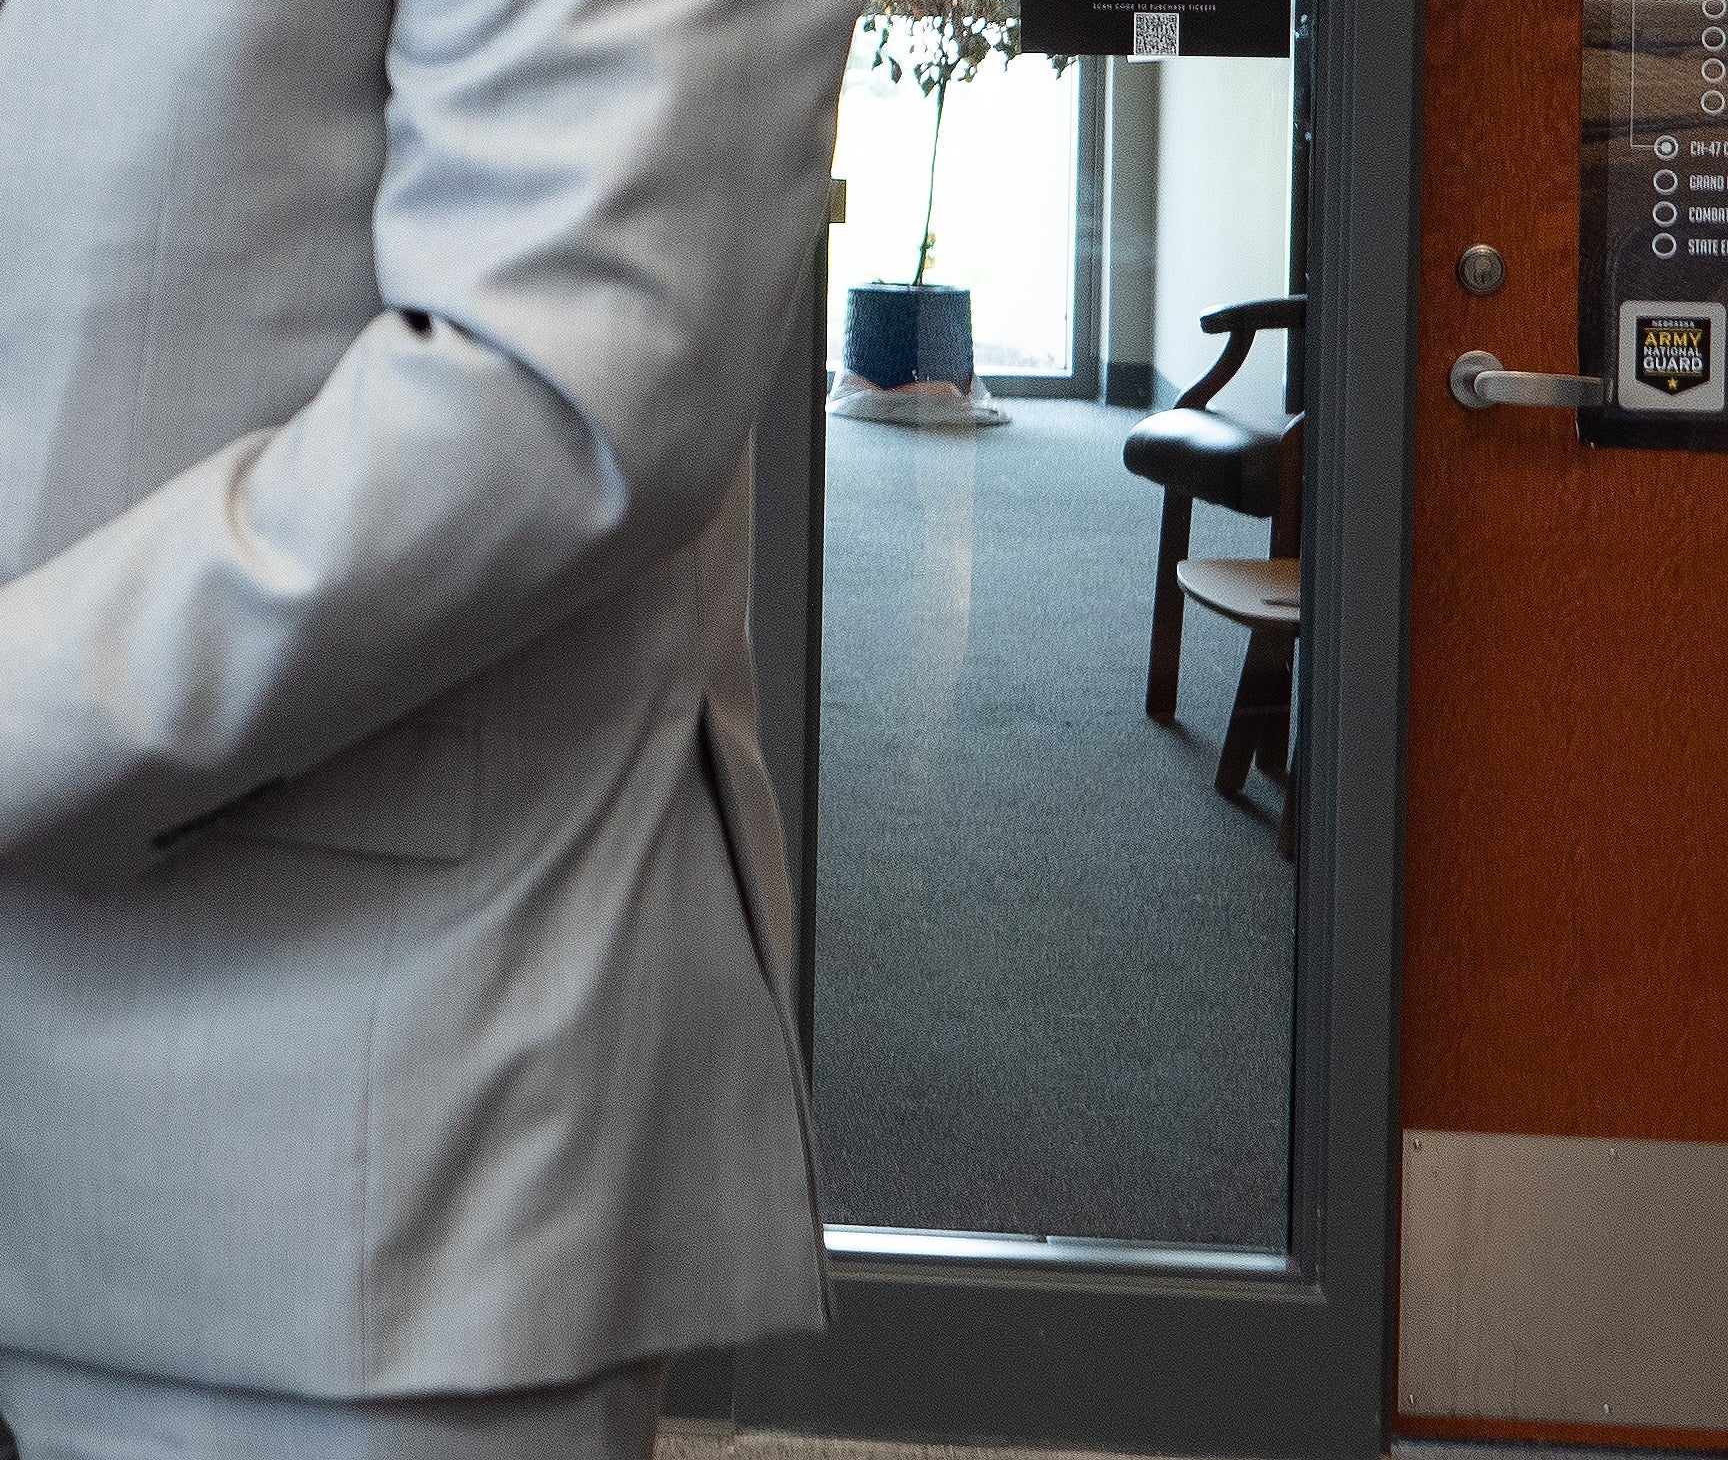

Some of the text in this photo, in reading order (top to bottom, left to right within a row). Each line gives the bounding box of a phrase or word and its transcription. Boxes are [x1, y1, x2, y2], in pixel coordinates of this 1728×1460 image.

[1687, 238, 1719, 256] STATE
[1645, 331, 1702, 348] ARMY
[1644, 346, 1703, 358] NATIONAL
[1643, 357, 1704, 372] GUARD
